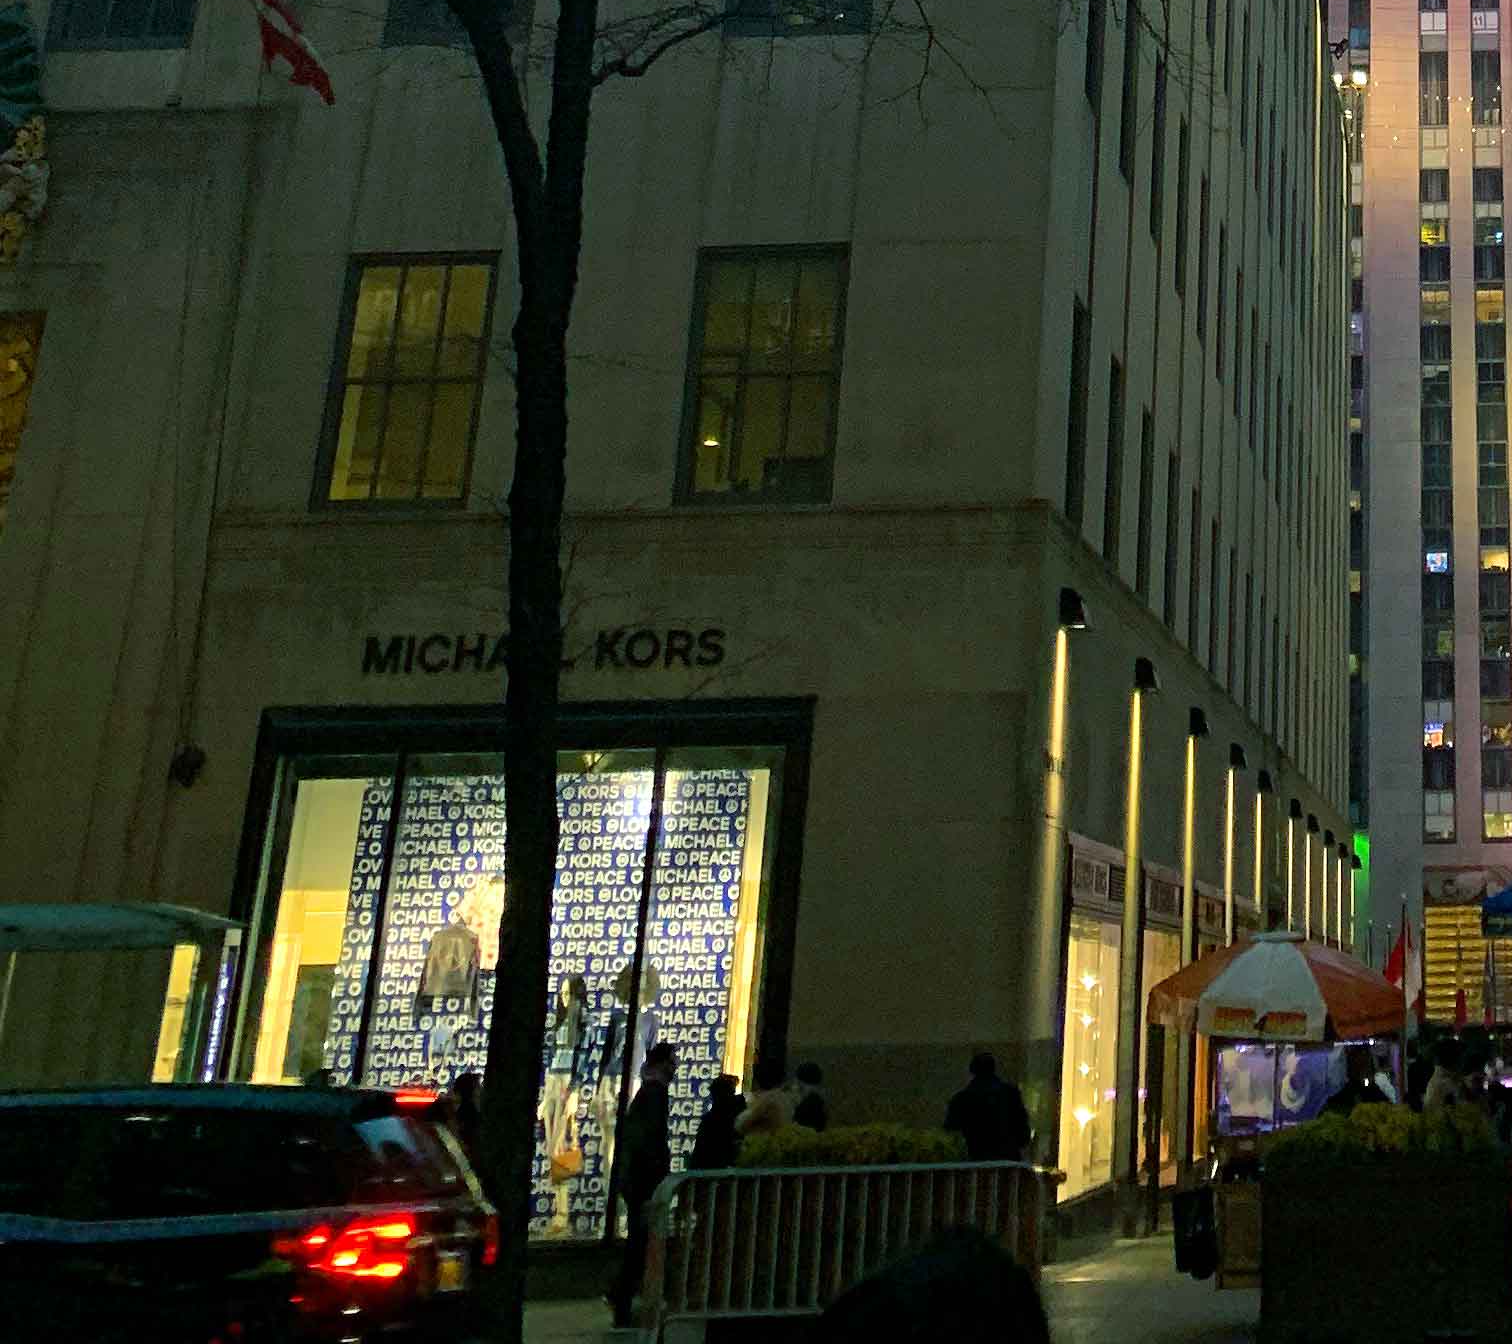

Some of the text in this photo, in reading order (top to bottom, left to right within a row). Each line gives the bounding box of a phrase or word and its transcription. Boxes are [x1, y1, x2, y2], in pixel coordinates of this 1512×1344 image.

[595, 629, 726, 671] KORS
[420, 789, 470, 802] PEACE
[578, 785, 619, 799] KORS
[696, 783, 747, 796] PEACE
[582, 803, 634, 816] PEACE
[400, 823, 452, 837] PEACE
[559, 820, 601, 834] KORS
[679, 817, 730, 831] PEACE
[593, 837, 644, 850] PEACE
[664, 834, 734, 848] MICHAEL
[410, 858, 462, 871] PEACE
[569, 854, 612, 867] KORS
[689, 851, 741, 865] PEACE
[575, 871, 625, 885] PEACE
[392, 892, 443, 906] PEACE
[553, 888, 594, 902] KORS
[672, 886, 723, 900] PEACE
[585, 905, 637, 920] PEACE
[657, 904, 727, 918] MICHAEL
[562, 923, 604, 938] KORS
[682, 921, 734, 935] PEACE
[566, 941, 618, 955] PEACE
[664, 956, 716, 971] PEACE
[674, 992, 728, 1006] PEACE
[371, 1034, 424, 1049] PEACE
[657, 1028, 710, 1043] PEACE
